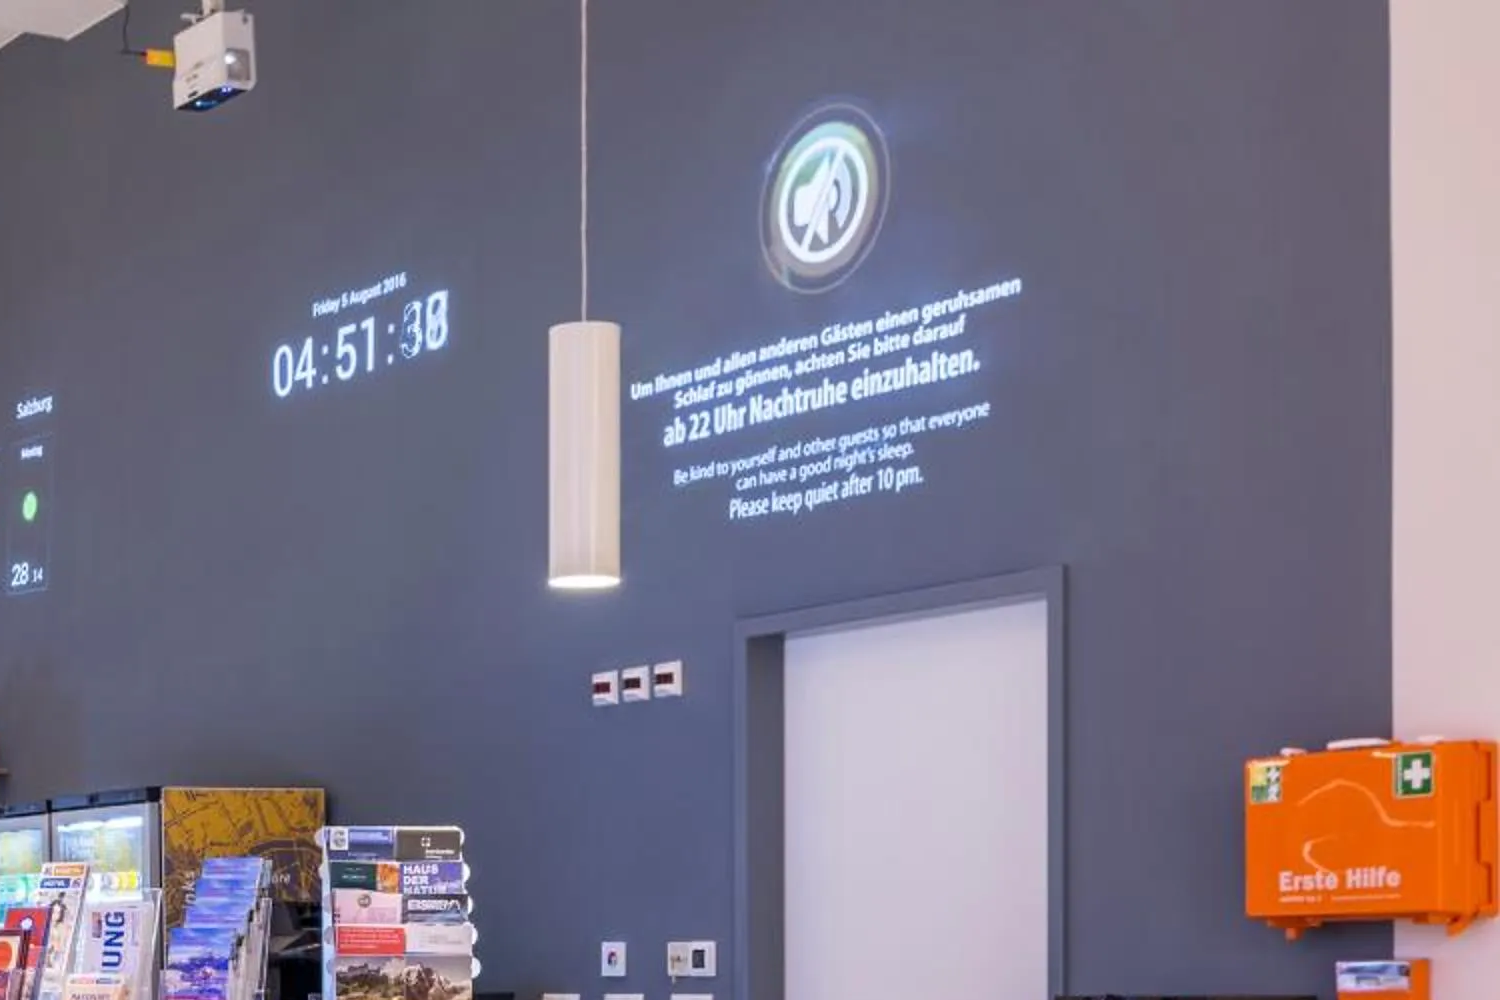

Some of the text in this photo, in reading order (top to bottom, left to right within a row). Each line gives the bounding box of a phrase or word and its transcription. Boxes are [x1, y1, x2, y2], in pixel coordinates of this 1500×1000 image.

[312, 272, 407, 317] Friday 5 August 2016
[630, 277, 1022, 400] Um Ihnen und allen anderen Gästen einen geruhsamen
[673, 312, 966, 409] Schlaf zu gönnen, achten Sie bitte darauf
[663, 348, 981, 447] ab 22 Uhr Nachtruhe einzuhalten.
[673, 401, 991, 486] Be kind to yourself and other guests so that everyone
[729, 465, 924, 520] Please keep quiet after 10 pm.
[735, 474, 756, 491] can
[759, 469, 788, 486] have
[789, 467, 797, 481] a
[799, 454, 831, 482] good
[11, 562, 29, 587] 28
[403, 876, 428, 885] DER
[1278, 866, 1402, 893] Erste Hilfe
